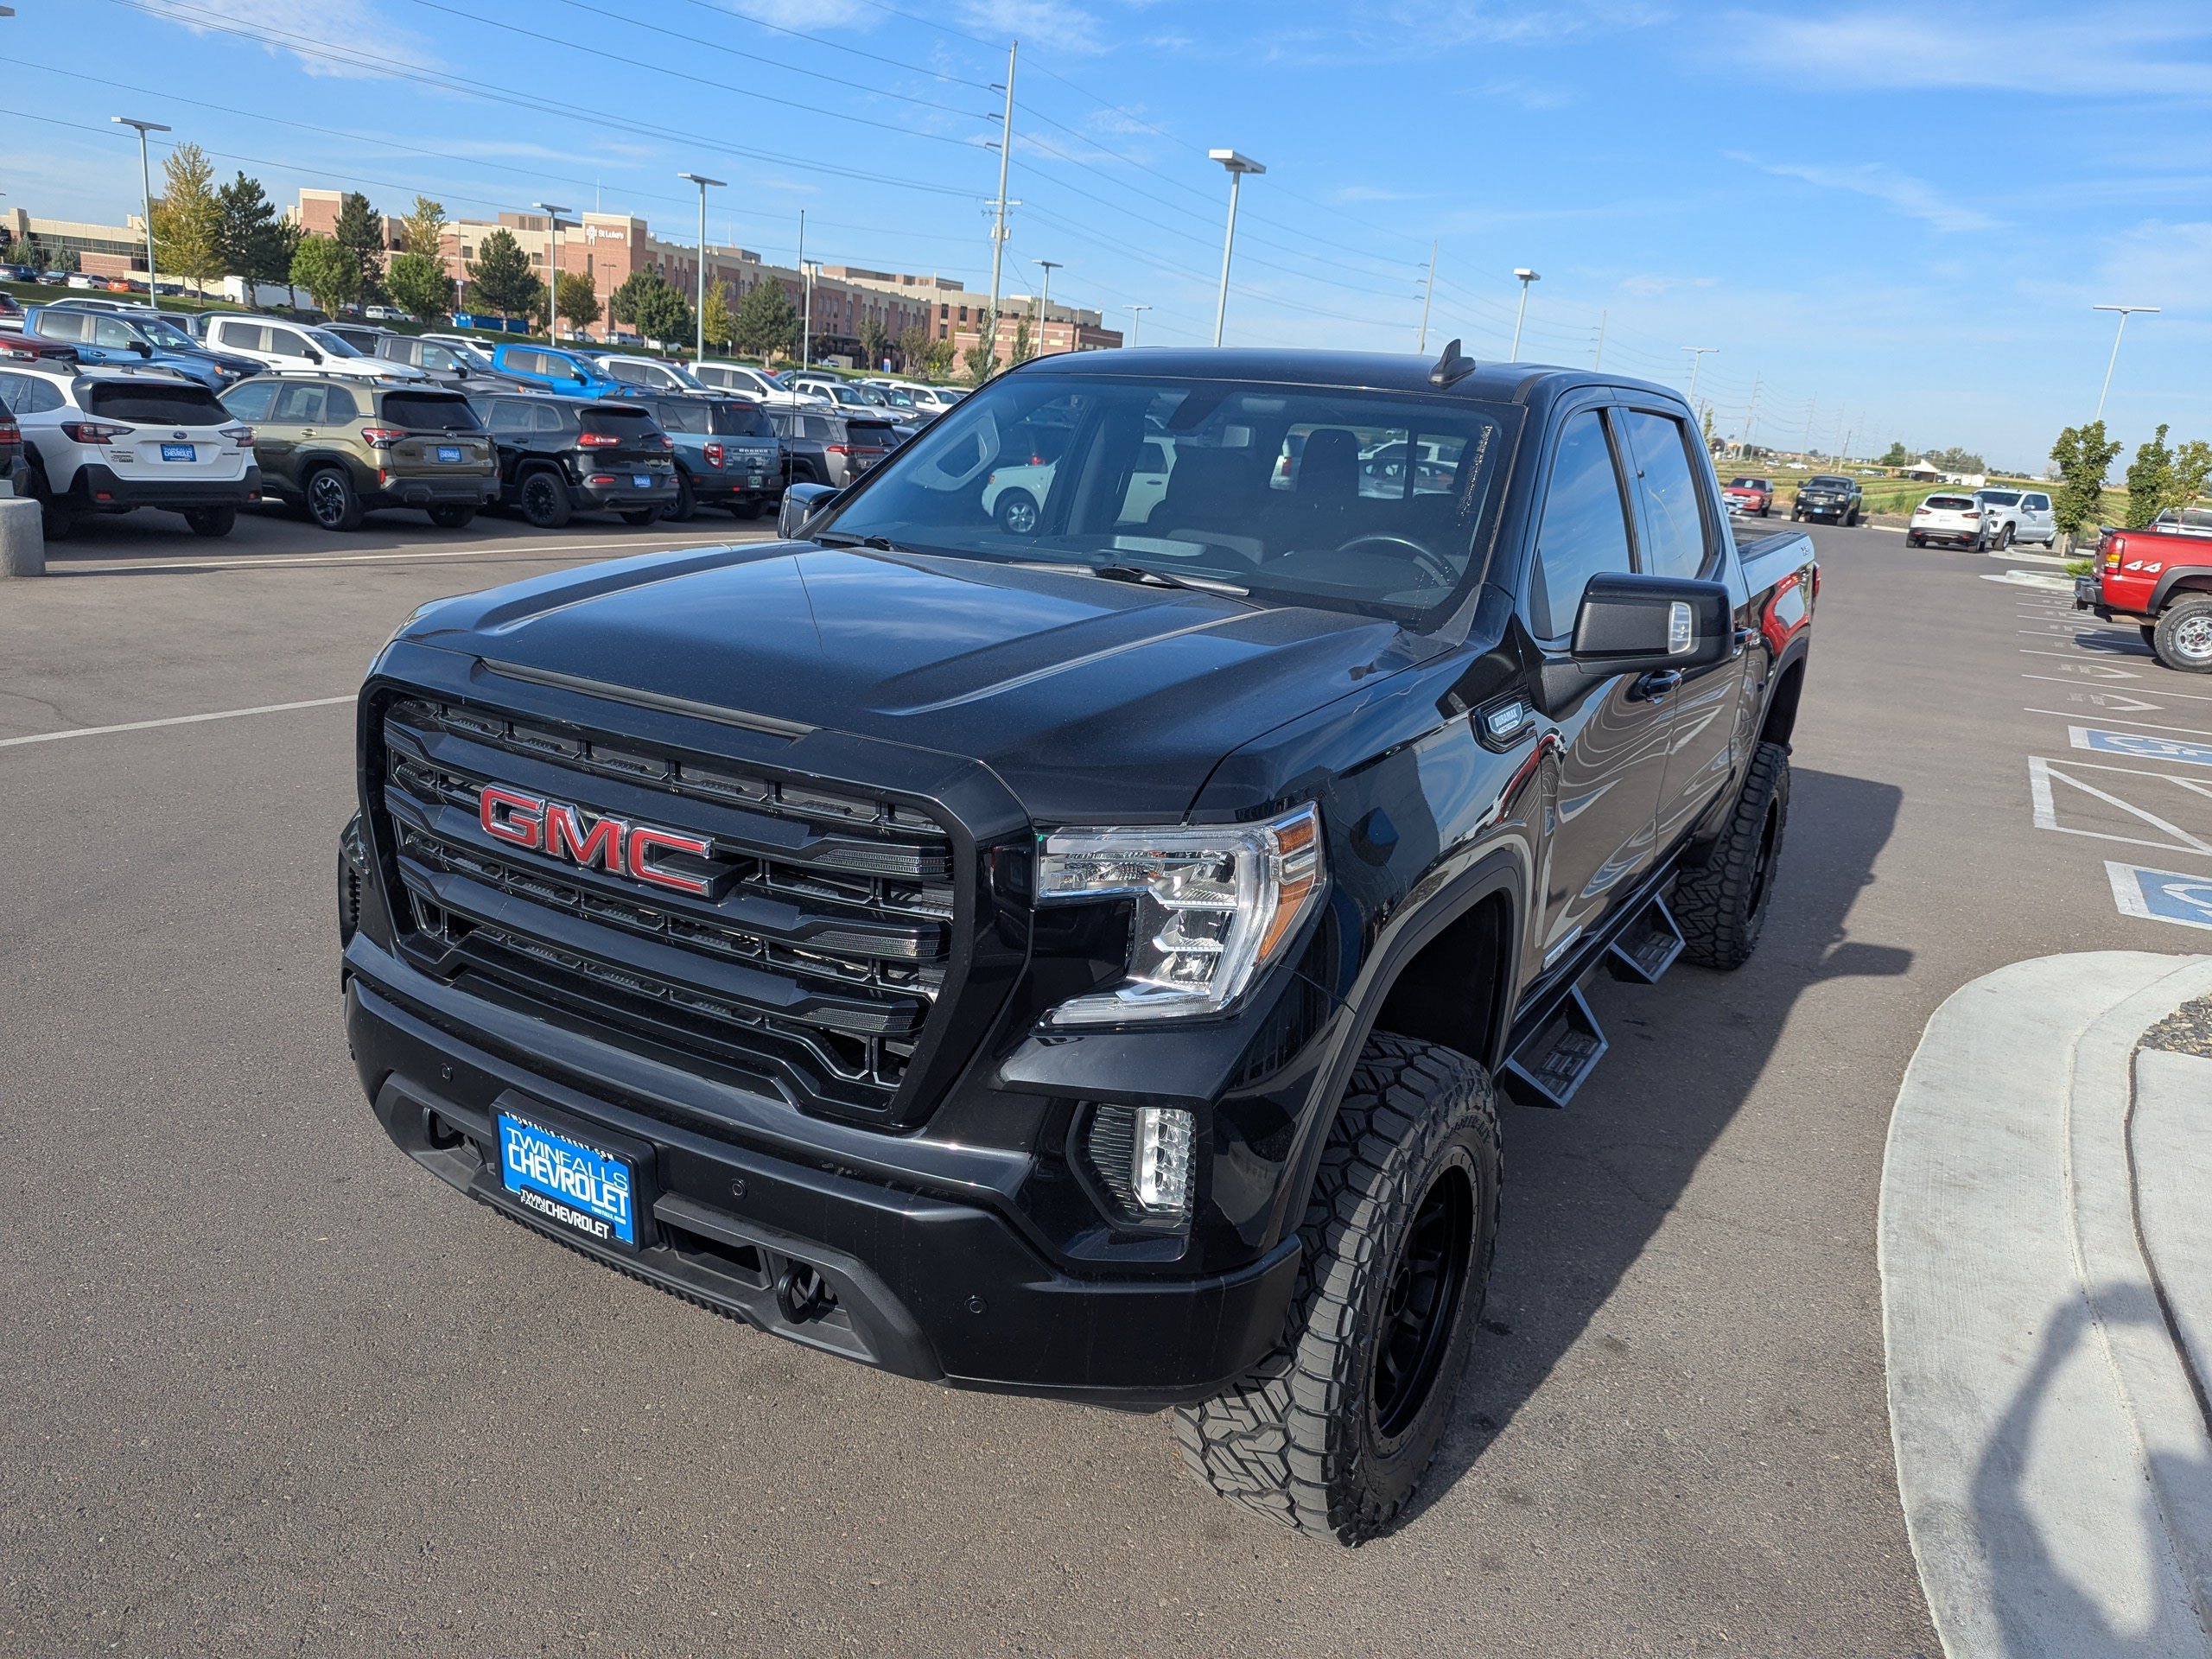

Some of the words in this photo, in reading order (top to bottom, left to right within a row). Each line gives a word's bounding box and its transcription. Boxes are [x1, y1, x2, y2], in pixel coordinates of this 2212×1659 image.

[1495, 708, 1518, 727] DURAMAX
[480, 782, 715, 898] GMC
[508, 1143, 629, 1217] CHEVROLET
[520, 1189, 546, 1209] TWIN
[520, 1197, 546, 1213] FALLS
[545, 1199, 609, 1239] CHEVROLET
